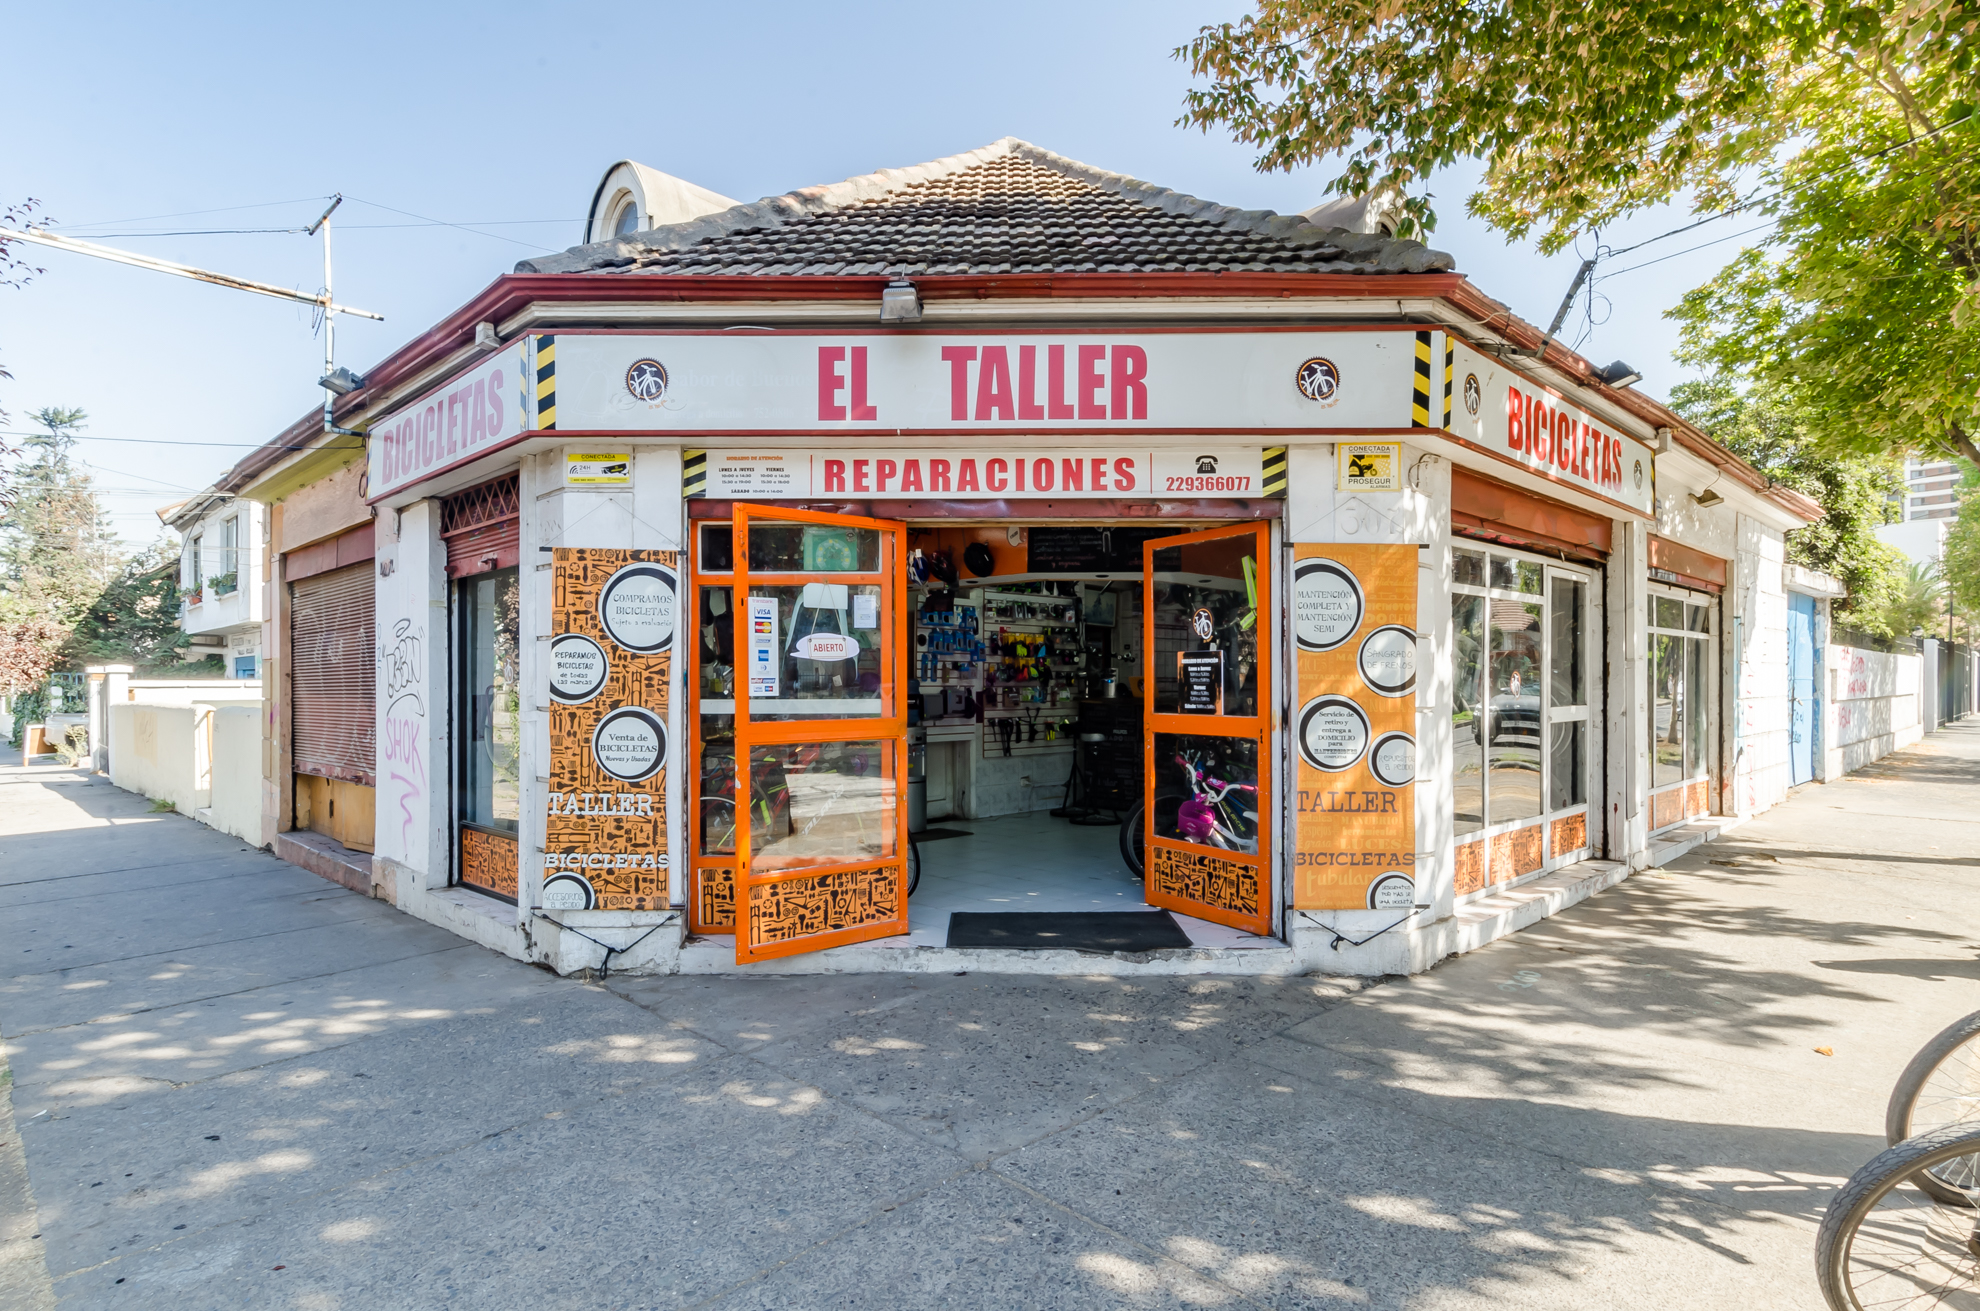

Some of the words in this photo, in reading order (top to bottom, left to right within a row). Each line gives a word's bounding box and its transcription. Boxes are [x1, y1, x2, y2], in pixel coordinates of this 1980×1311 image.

[818, 345, 877, 421] EL
[941, 344, 1148, 421] TALLER
[381, 368, 504, 486] BICICLETAS
[1508, 385, 1623, 494] BICICLETAS
[823, 457, 1137, 493] REPARACIONES
[1165, 474, 1252, 491] 229366077
[613, 593, 673, 604] COMPRAMOS
[1297, 590, 1353, 599] MANTENCIÓN
[615, 606, 670, 616] BICICLETAS
[1297, 602, 1342, 611] COMPLETA
[1345, 602, 1351, 610] Y
[1297, 612, 1353, 622] MANTENCIÓN
[1313, 624, 1335, 633] SEMI
[813, 642, 844, 652] ABIERTO
[1366, 647, 1413, 658] SANGRADO
[554, 651, 597, 659] REPARAMOS
[557, 661, 594, 670] BICICLETAS
[1367, 661, 1378, 669] DE
[1380, 661, 1413, 670] FRENOS
[608, 733, 635, 741] Venta
[637, 733, 648, 741] de
[385, 716, 427, 790] SHOK
[600, 744, 658, 752] BICICLETAS
[548, 792, 654, 816] TALLER
[1296, 790, 1398, 813] TALLER
[1340, 838, 1402, 850] LUCES
[544, 852, 670, 869] BICICLETAS
[1295, 852, 1416, 866] BICICLETAS
[1306, 868, 1374, 897] tubular
[544, 892, 584, 901] ACCESORIOS
